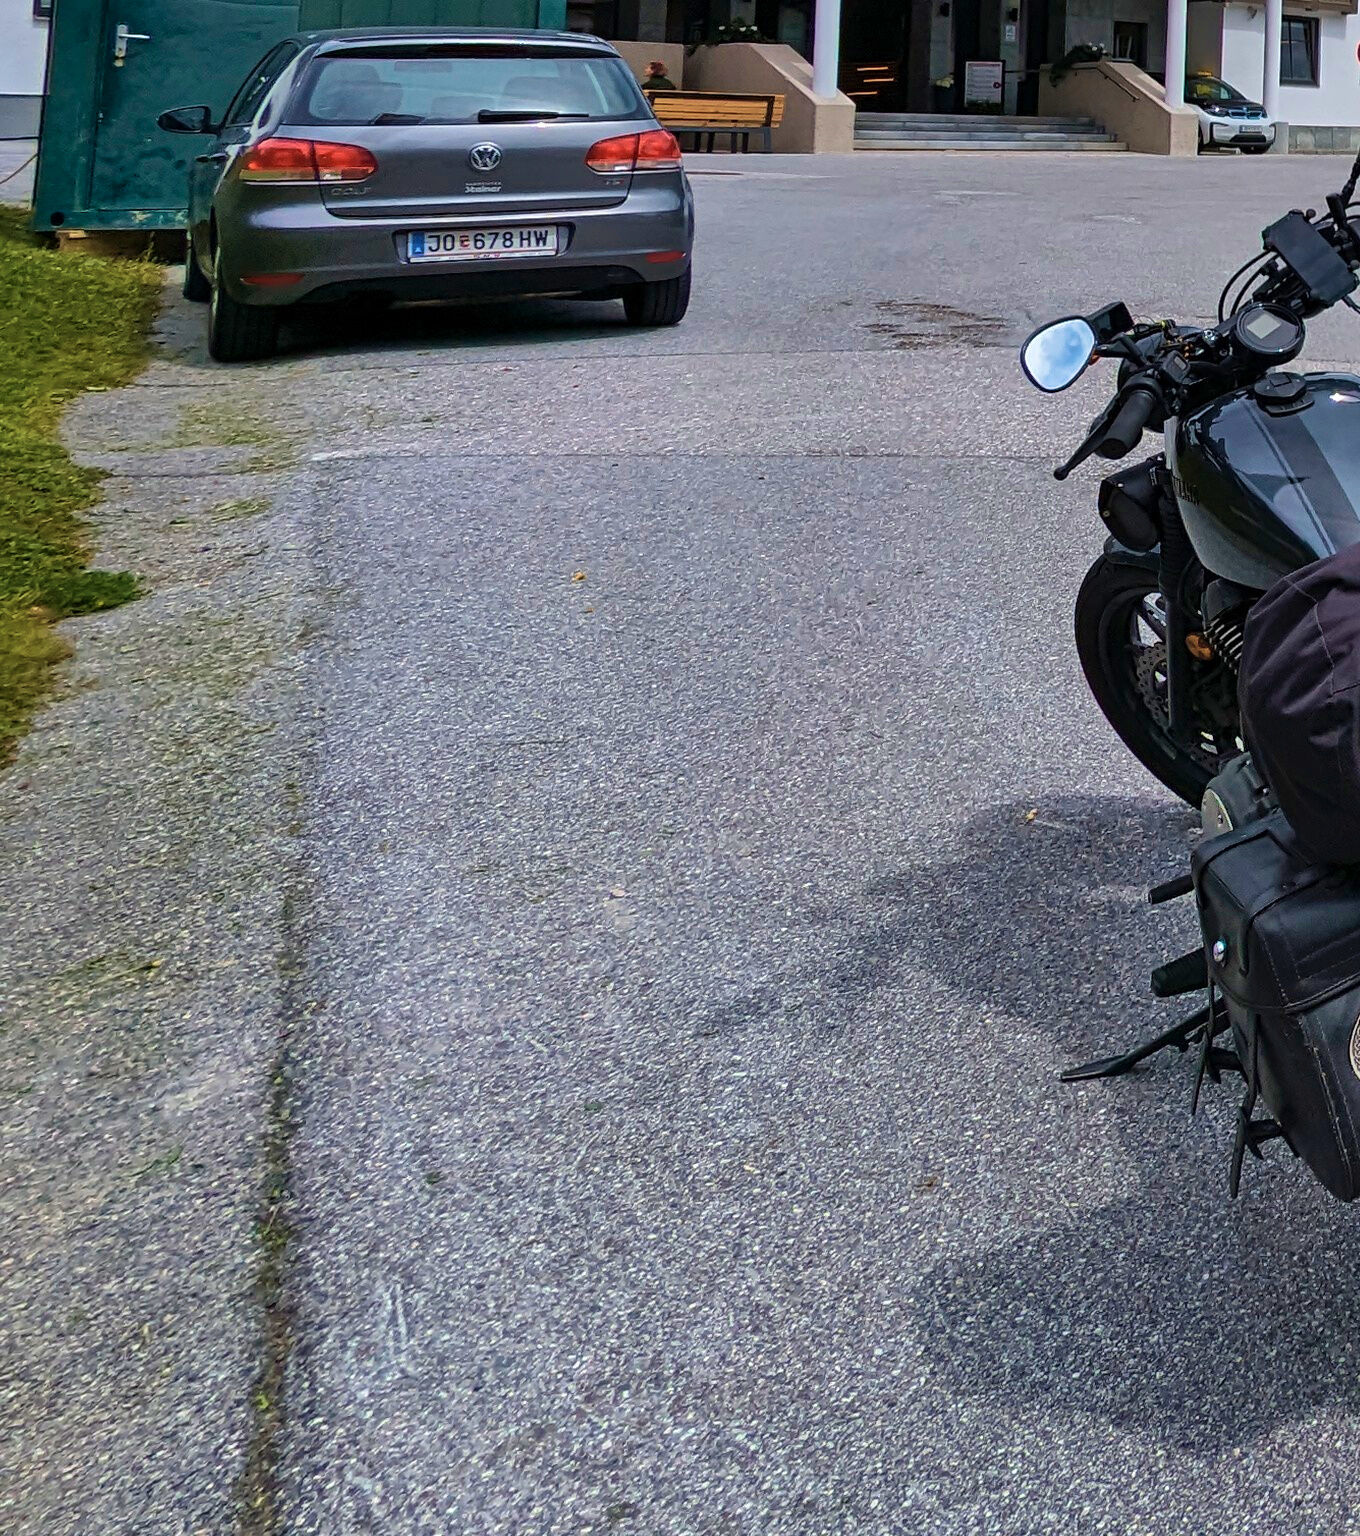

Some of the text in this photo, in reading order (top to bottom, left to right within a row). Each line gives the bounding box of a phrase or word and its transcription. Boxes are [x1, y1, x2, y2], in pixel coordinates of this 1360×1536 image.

[427, 229, 549, 252] JO 678 HW
